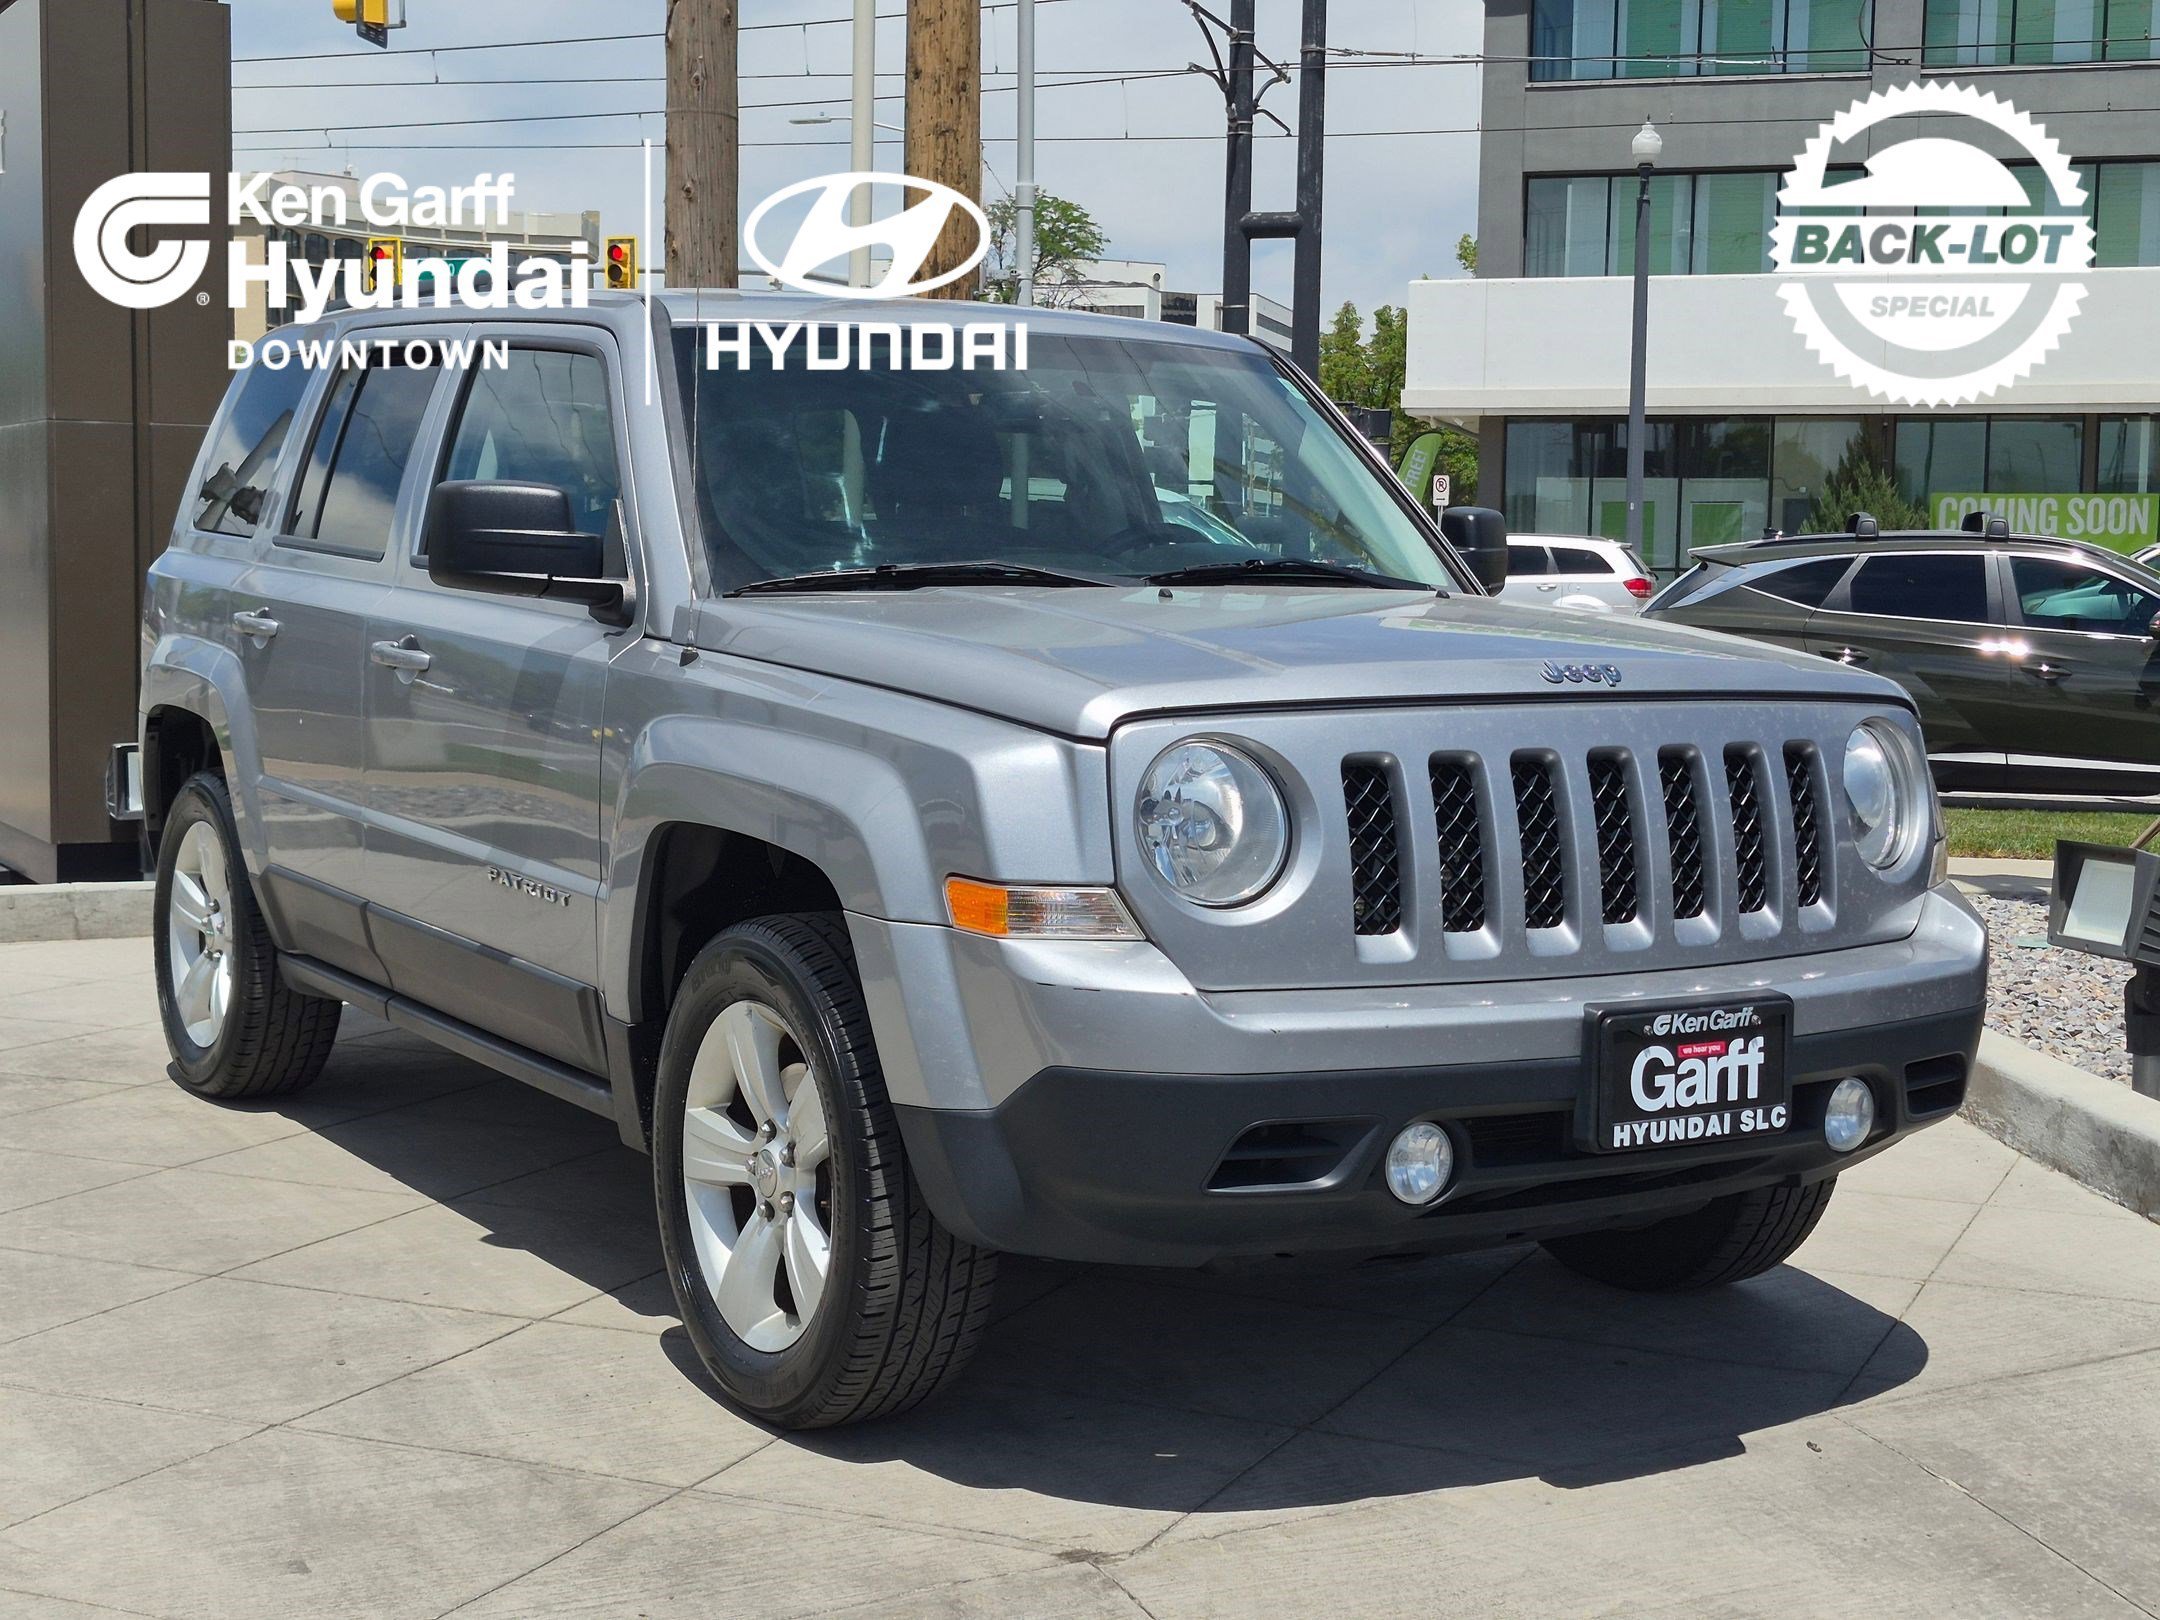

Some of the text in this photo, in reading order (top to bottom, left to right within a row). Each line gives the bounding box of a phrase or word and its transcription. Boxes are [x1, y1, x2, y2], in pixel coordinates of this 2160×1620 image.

[2066, 497, 2148, 534] SOON
[1539, 659, 1622, 687] Jeep
[487, 865, 571, 907] PATRIOT
[1671, 1007, 1753, 1034] Ken Garff
[1631, 1036, 1764, 1111] Garff
[1614, 1106, 1786, 1147] HYUNDAI SLC
